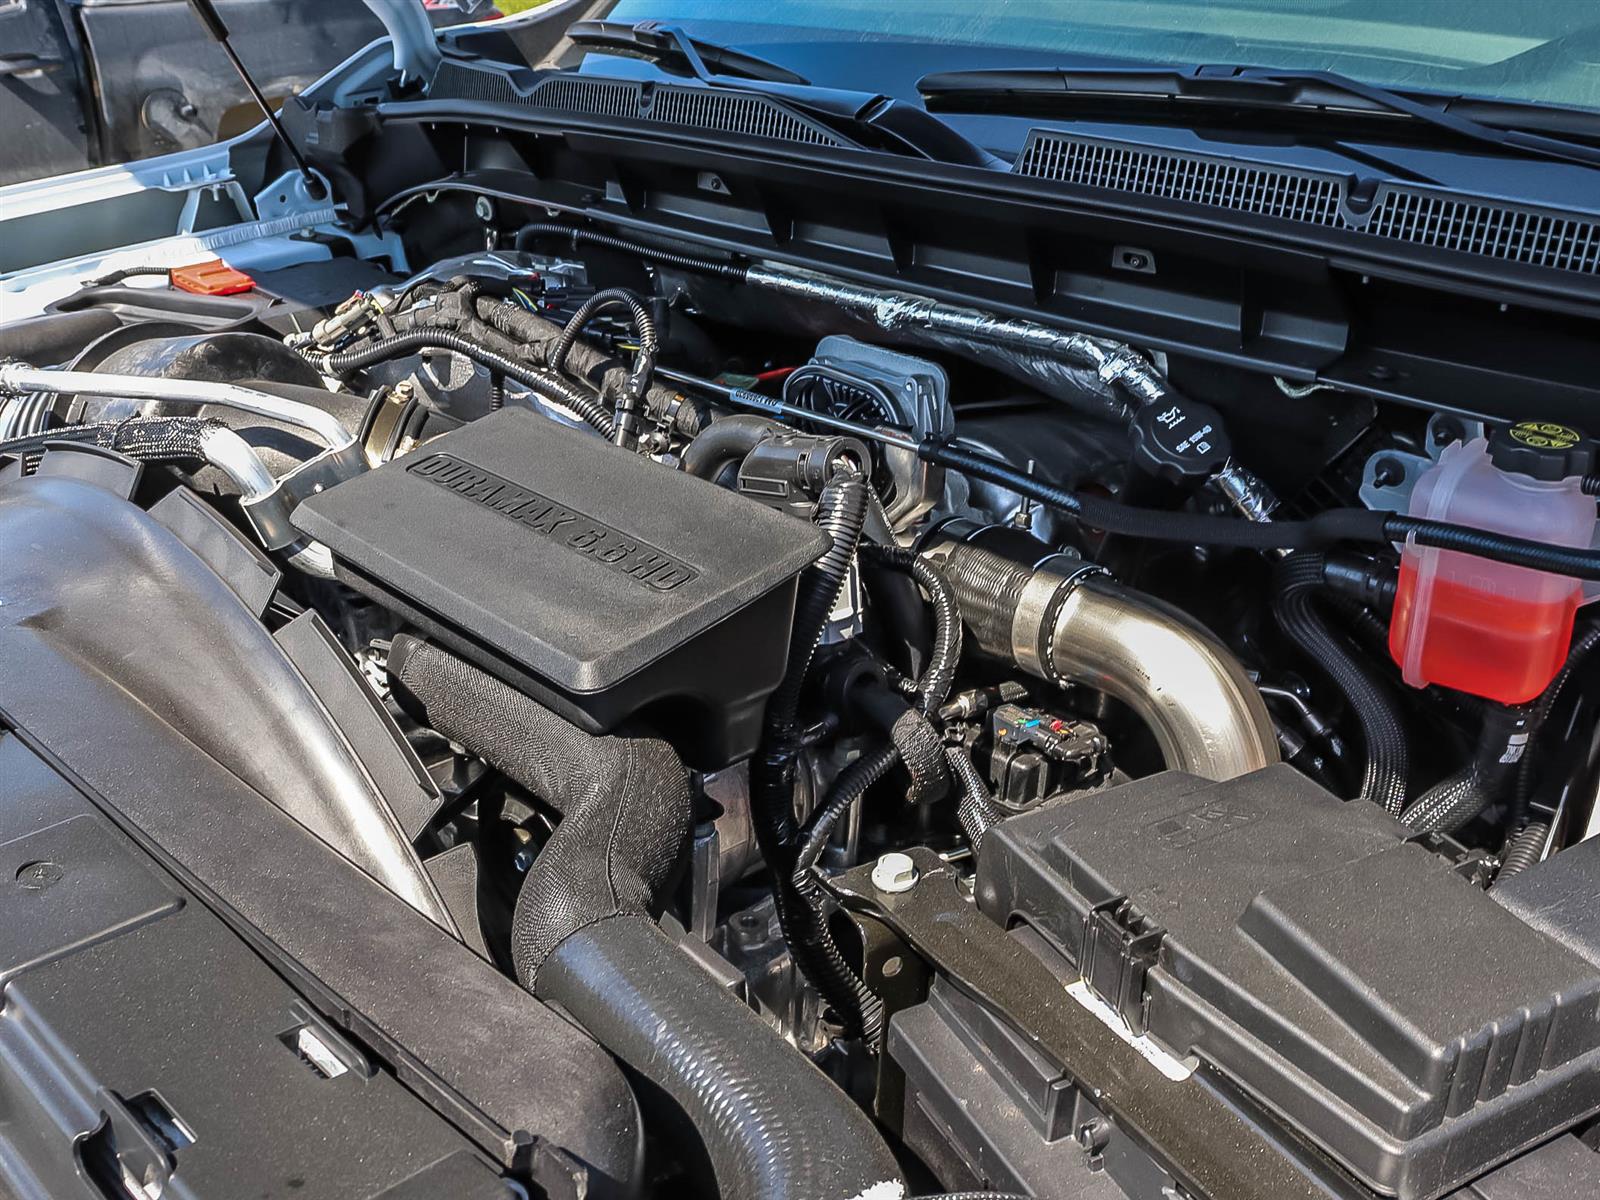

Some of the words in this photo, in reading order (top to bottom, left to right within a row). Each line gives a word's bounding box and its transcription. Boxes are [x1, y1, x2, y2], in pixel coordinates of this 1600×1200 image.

[1176, 440, 1190, 453] SAE
[410, 457, 576, 536] DURAMAX
[565, 527, 637, 564] 6.6
[621, 553, 692, 593] HD
